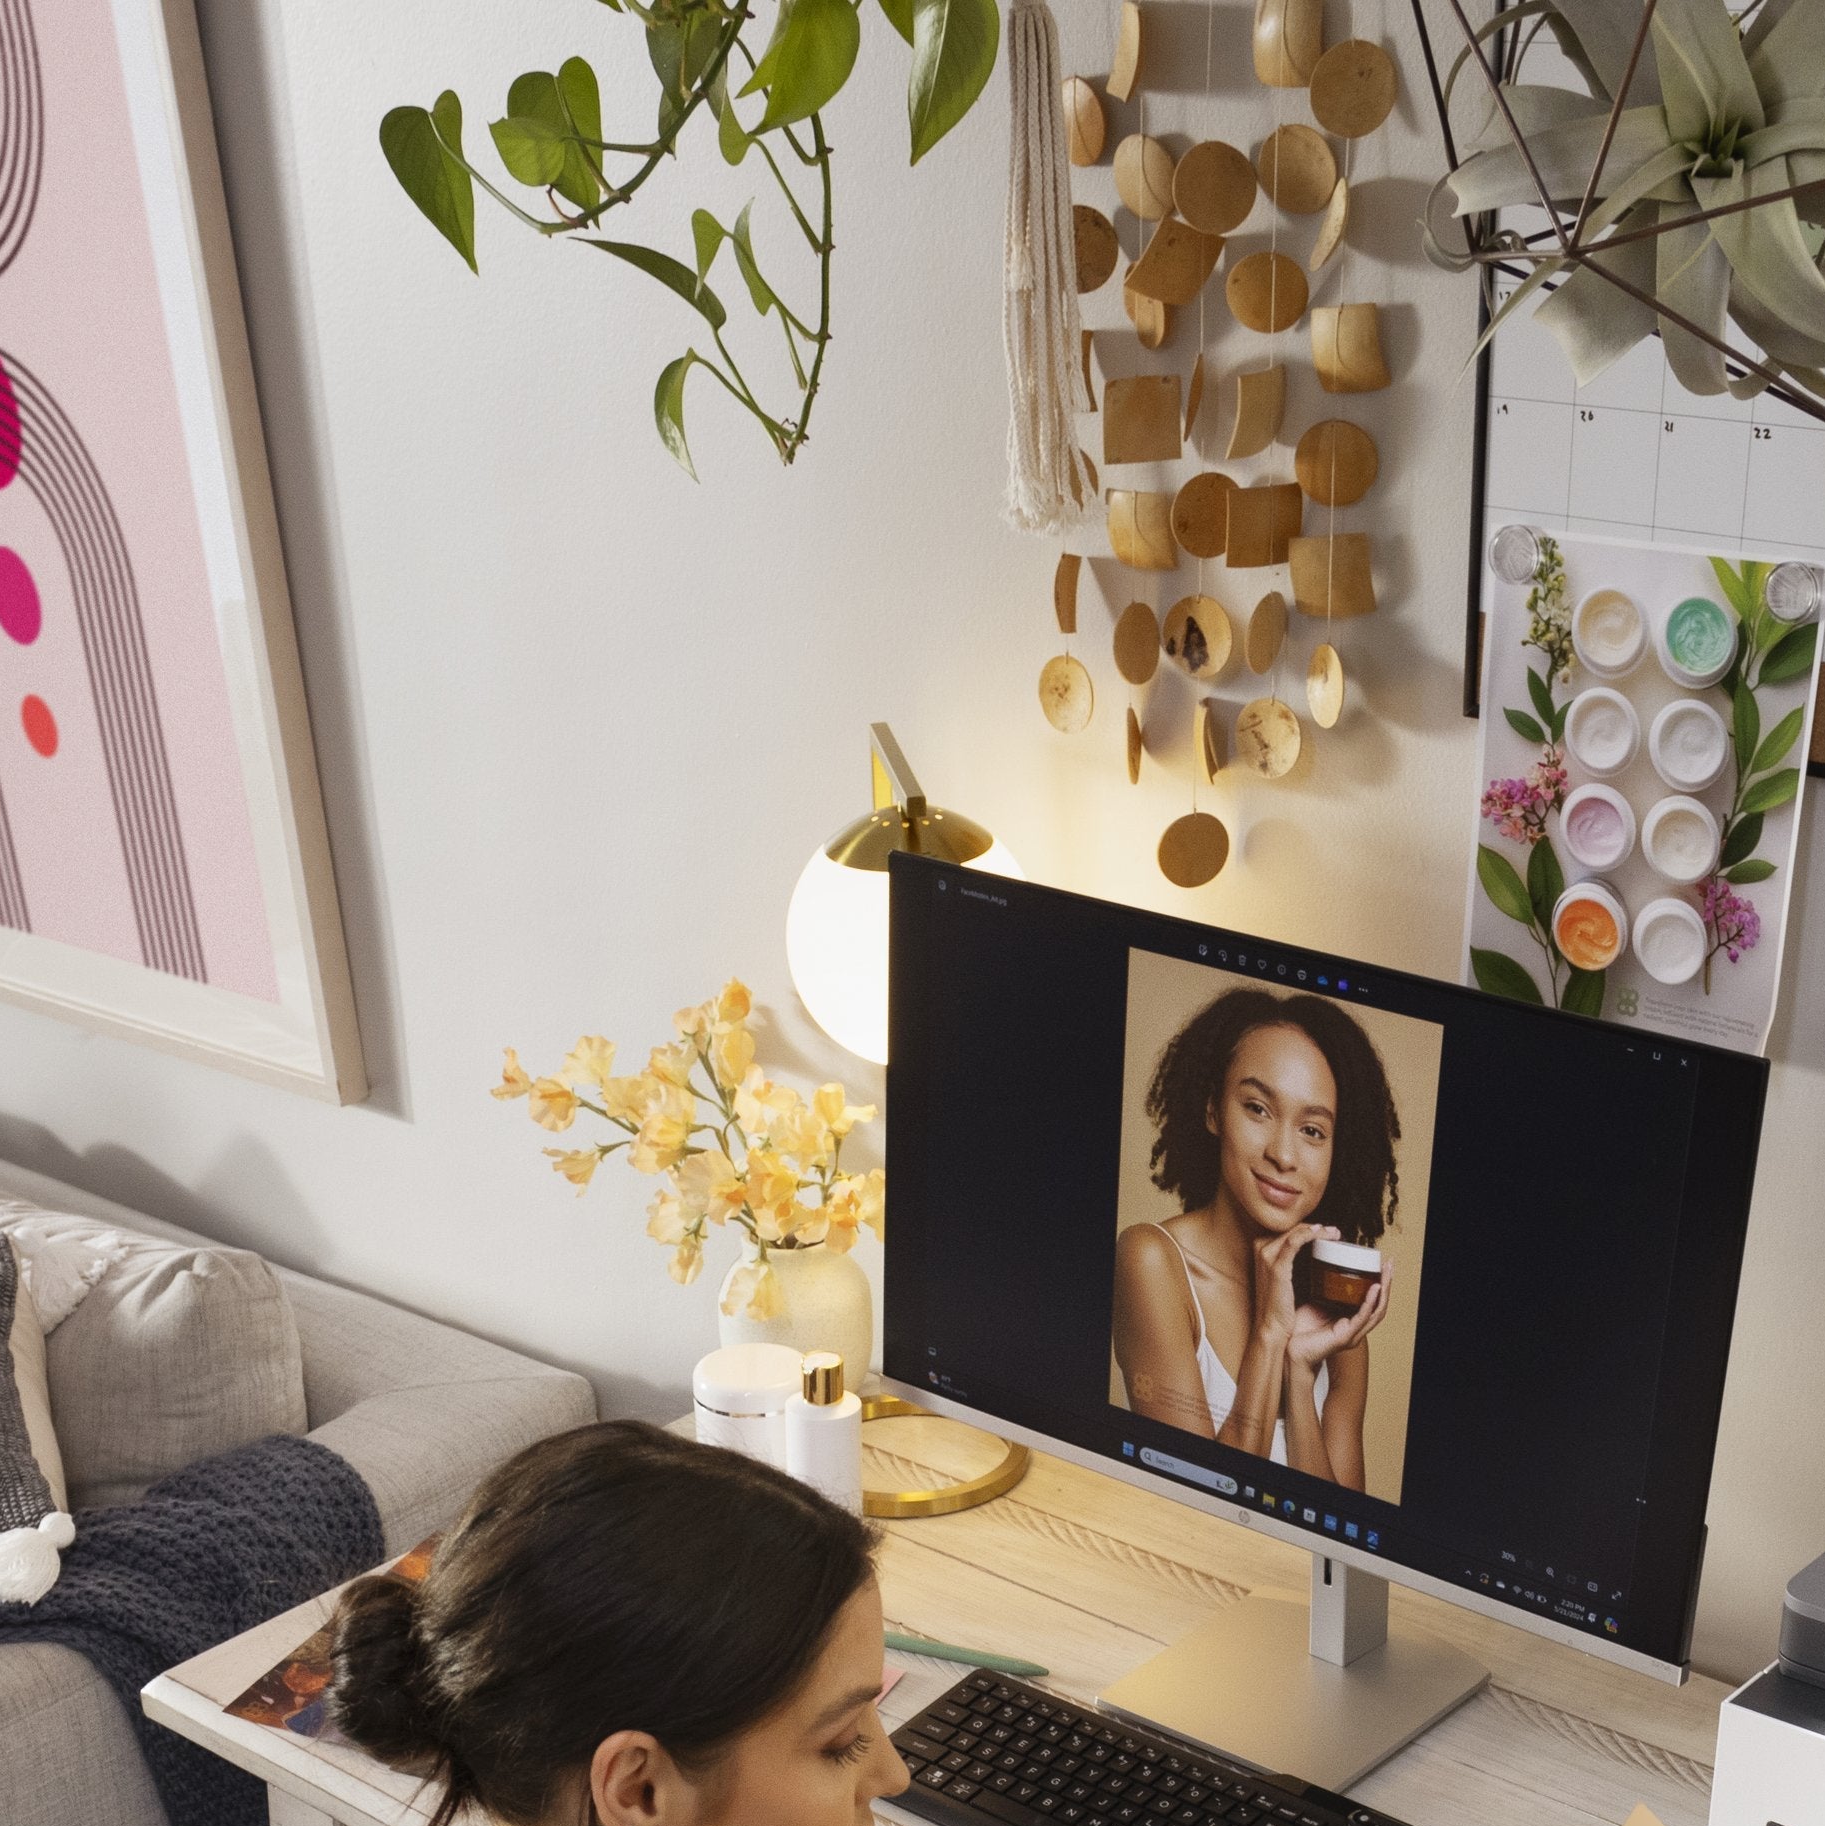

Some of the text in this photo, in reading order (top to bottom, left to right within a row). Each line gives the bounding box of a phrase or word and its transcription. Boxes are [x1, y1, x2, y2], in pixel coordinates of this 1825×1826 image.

[1497, 404, 1509, 415] 19
[1664, 421, 1674, 433] 21
[1754, 427, 1772, 439] 22
